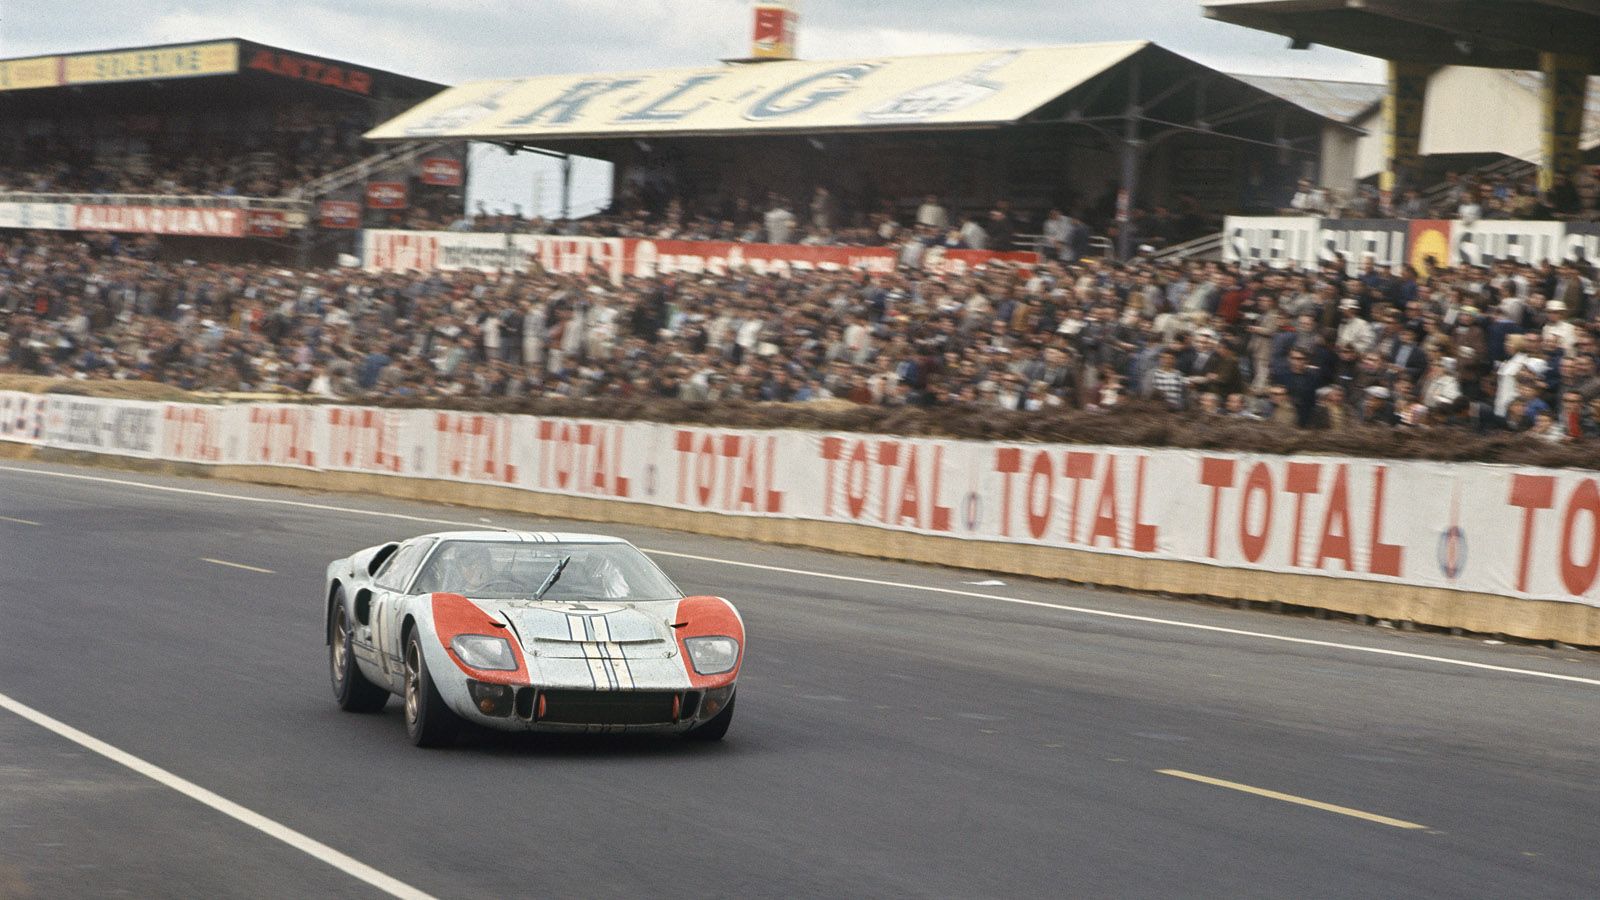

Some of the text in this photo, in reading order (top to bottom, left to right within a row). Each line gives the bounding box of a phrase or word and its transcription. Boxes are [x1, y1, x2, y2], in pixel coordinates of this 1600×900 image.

[250, 408, 315, 466] TOTAL
[436, 413, 518, 483] TOTAL
[537, 420, 629, 497] TOTAL
[675, 430, 782, 512] TOTAL
[821, 437, 952, 531] TOTAL
[994, 448, 1158, 552] TOTAL
[1200, 457, 1403, 577] TOTAL
